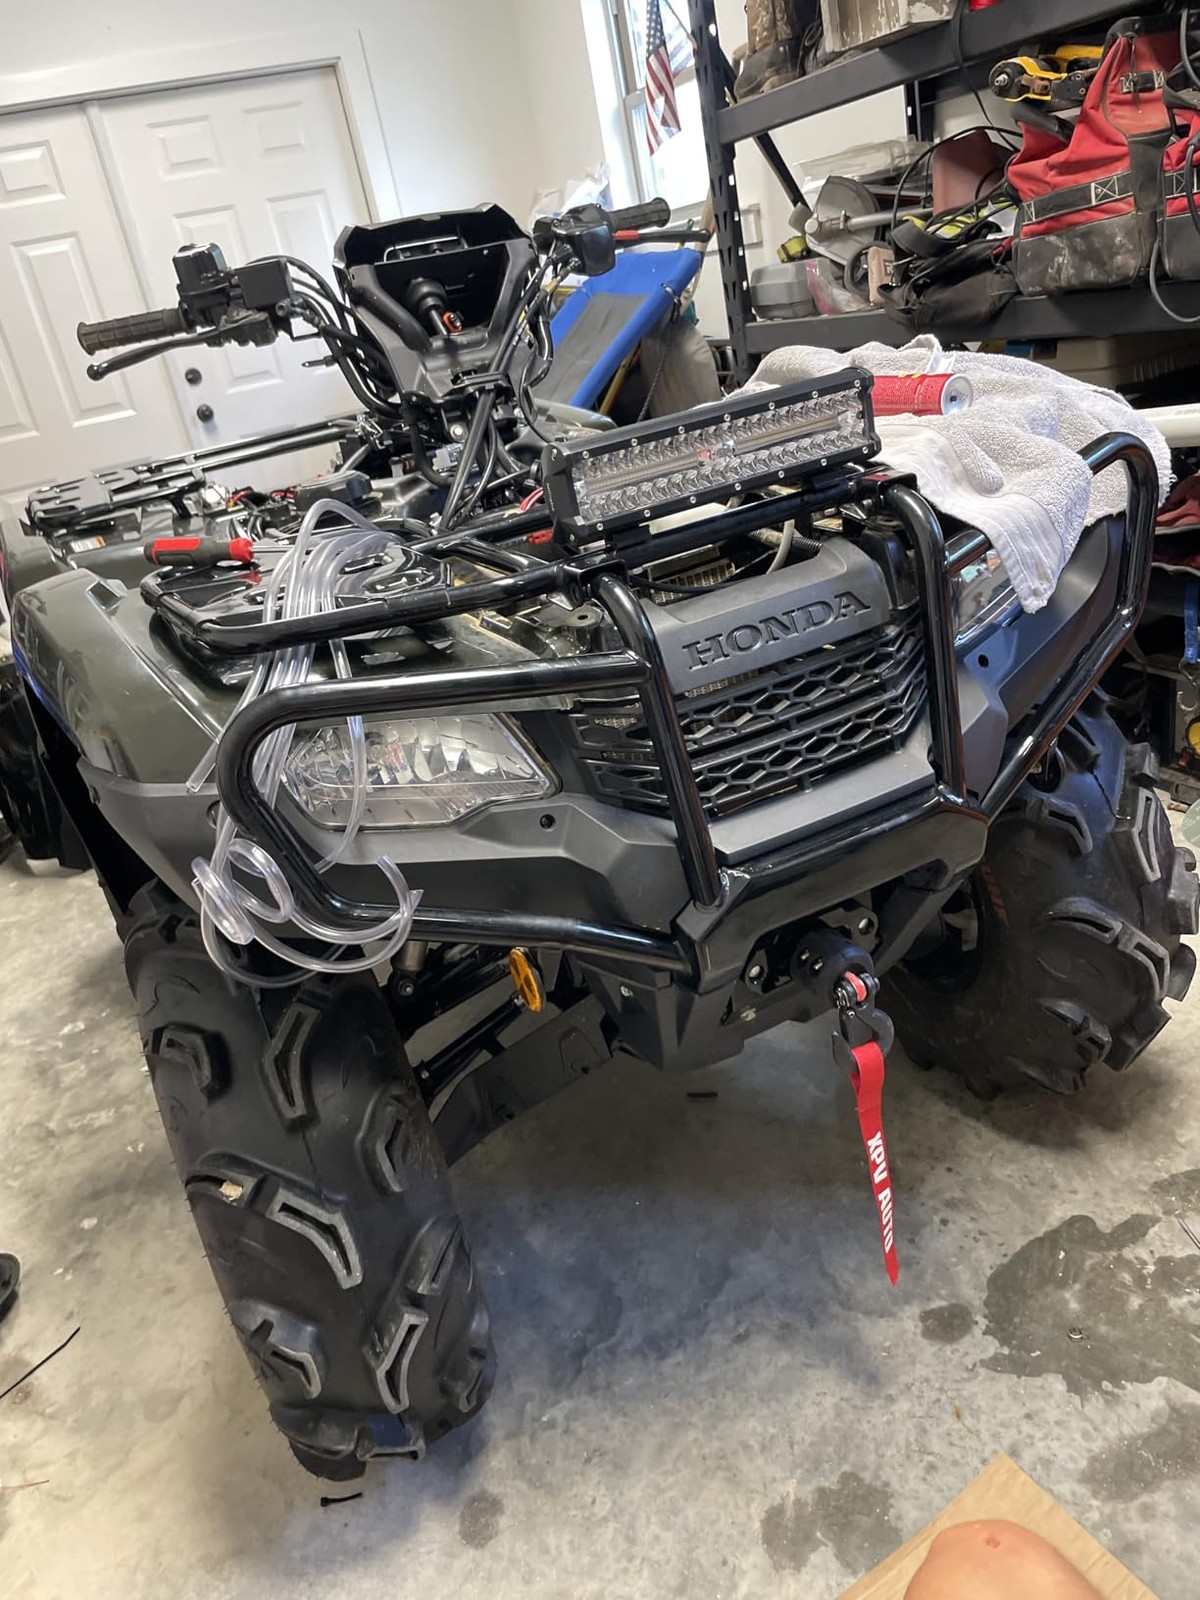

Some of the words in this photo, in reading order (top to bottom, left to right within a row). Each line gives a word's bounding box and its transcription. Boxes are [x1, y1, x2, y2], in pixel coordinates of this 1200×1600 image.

[682, 591, 871, 671] HONDA
[867, 1131, 888, 1184] XPV
[878, 1187, 894, 1254] AUTO
